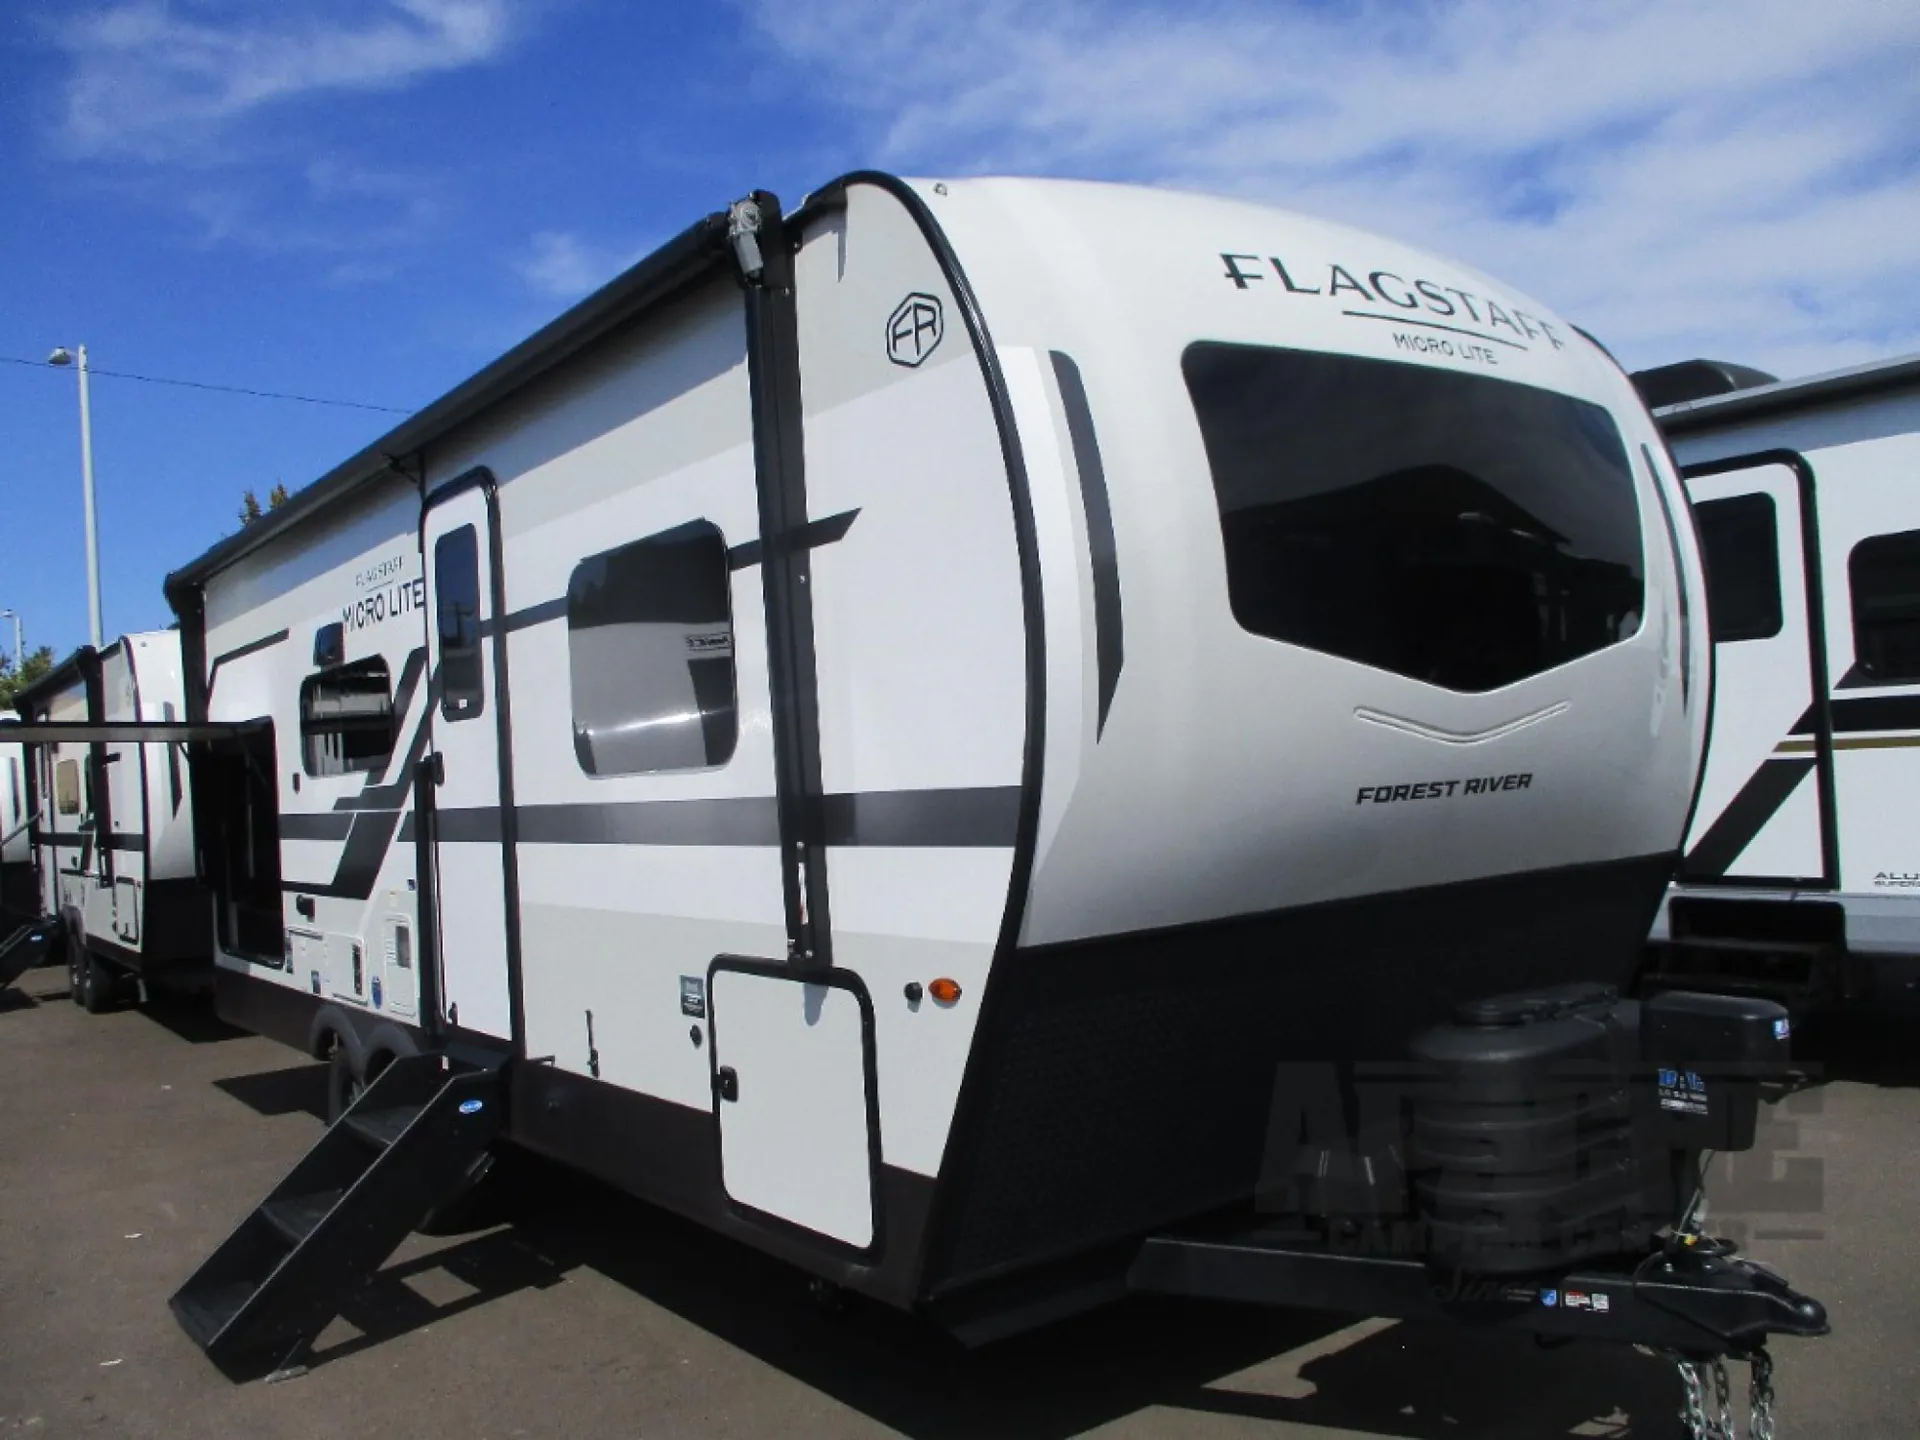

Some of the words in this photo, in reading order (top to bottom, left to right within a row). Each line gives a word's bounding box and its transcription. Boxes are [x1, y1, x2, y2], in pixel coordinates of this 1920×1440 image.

[1220, 252, 1565, 350] FLAGSTAFF
[1392, 332, 1454, 357] MICRO
[1461, 345, 1498, 365] LITE
[343, 592, 385, 632] MICRO
[389, 577, 425, 617] LITE
[1355, 780, 1460, 805] FOREST
[1463, 773, 1534, 796] RIVER
